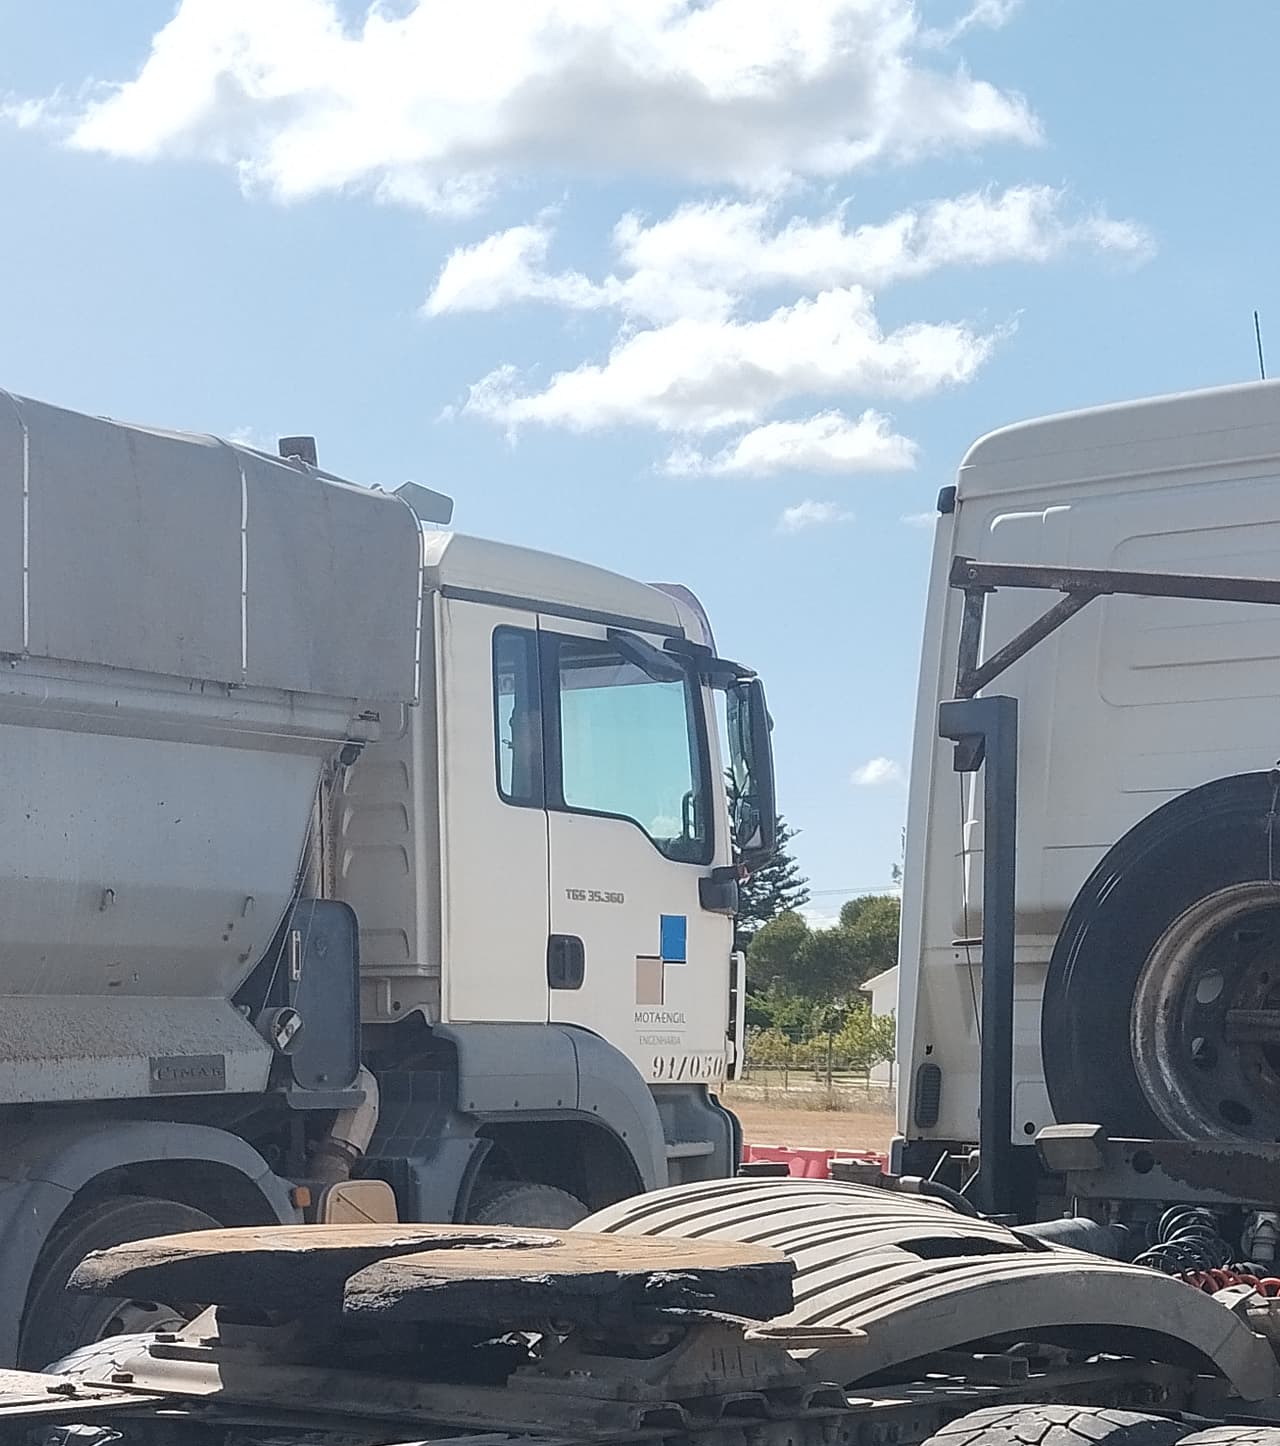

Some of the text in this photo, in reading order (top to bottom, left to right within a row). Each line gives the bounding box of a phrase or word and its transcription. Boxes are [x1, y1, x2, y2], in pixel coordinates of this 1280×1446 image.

[565, 888, 625, 904] TGS 35.360
[652, 1056, 723, 1081] 91/050
